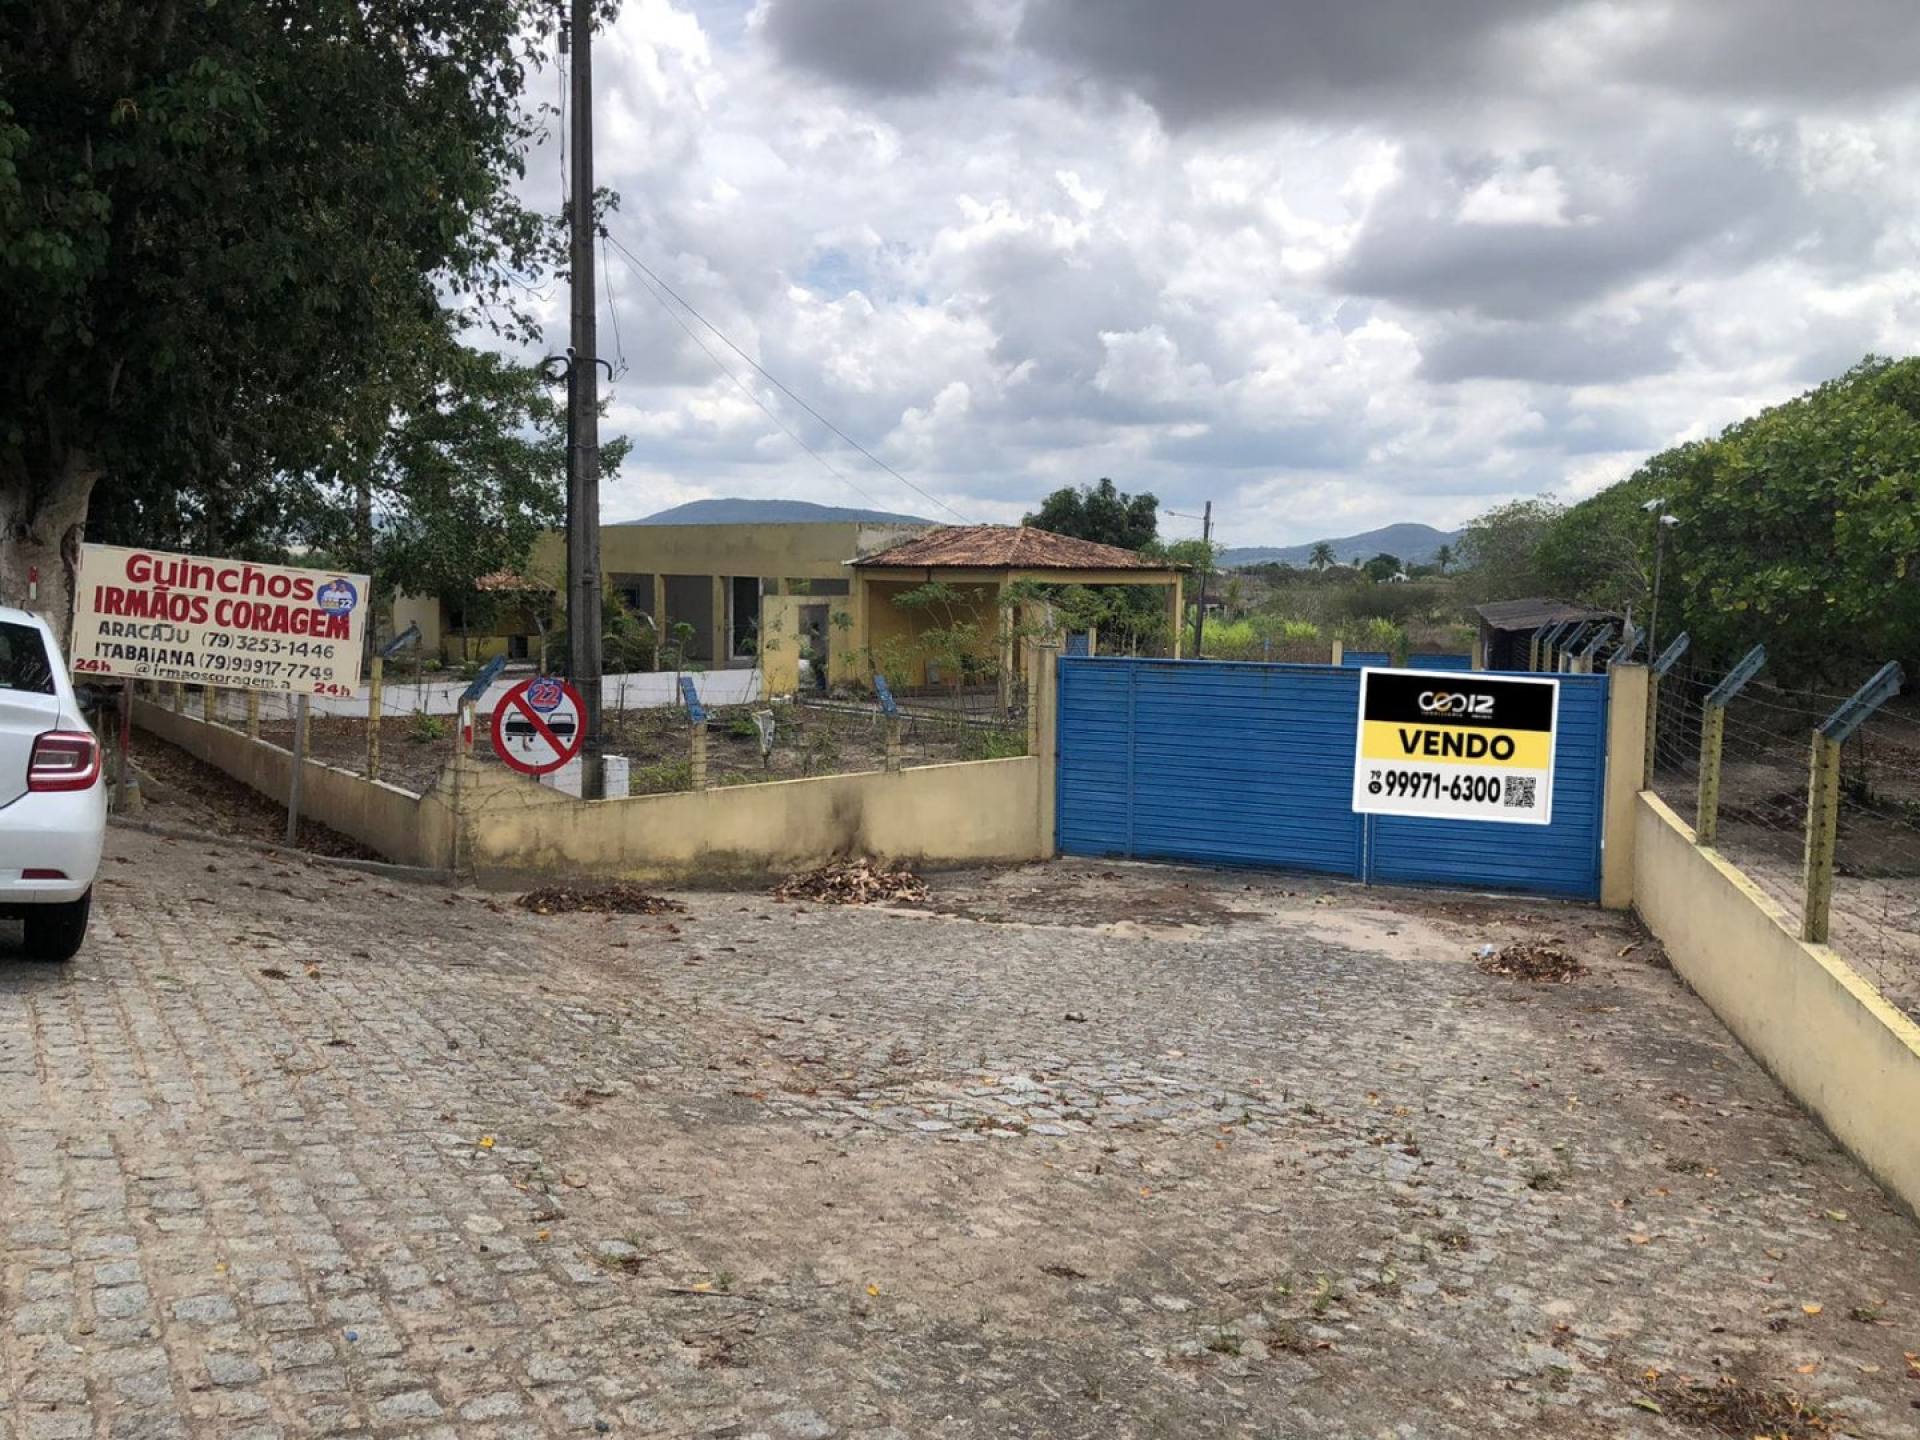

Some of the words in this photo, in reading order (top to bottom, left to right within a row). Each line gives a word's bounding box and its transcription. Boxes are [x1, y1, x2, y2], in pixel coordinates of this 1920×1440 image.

[126, 554, 314, 601] Guinchos
[94, 585, 209, 625] IRMÃOS
[215, 599, 350, 640] CORAGEM
[98, 620, 190, 643] ARACAJU
[75, 658, 111, 673] 24h
[95, 642, 195, 667] ITABAIANA
[313, 682, 351, 697] 24h
[531, 684, 559, 705] 22
[1399, 728, 1516, 761] VENDO
[1385, 770, 1501, 804] 99971-6300
